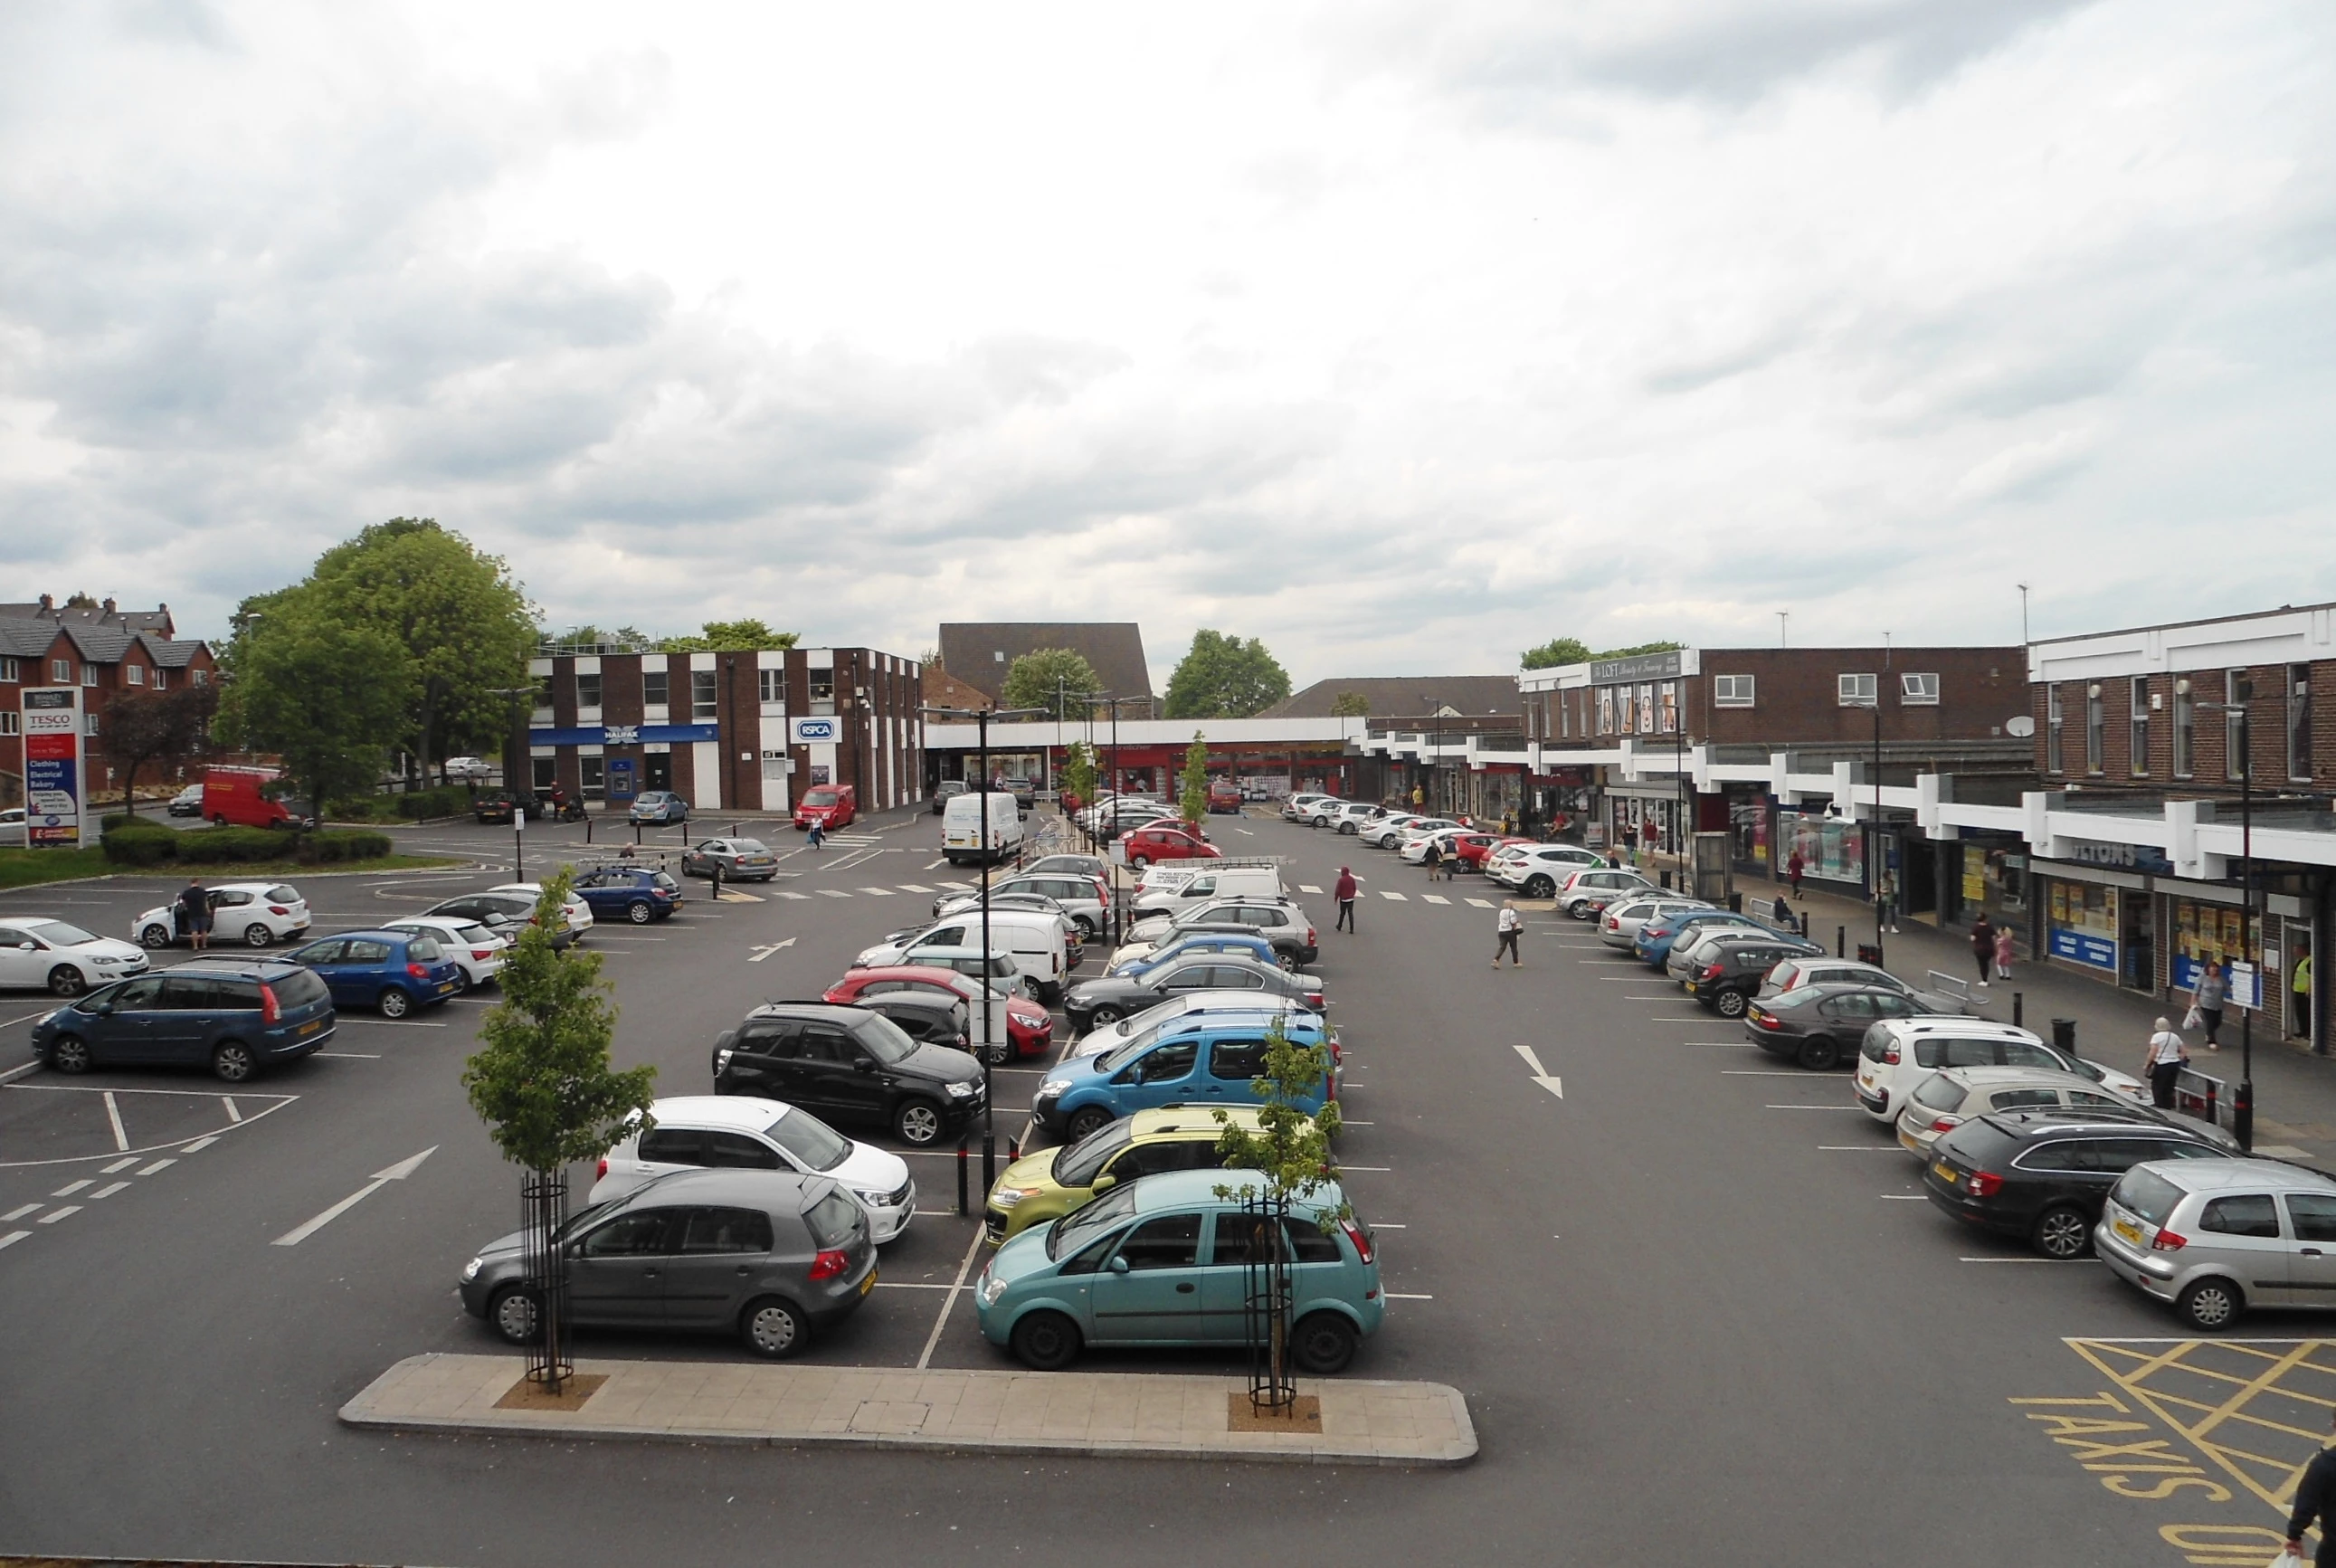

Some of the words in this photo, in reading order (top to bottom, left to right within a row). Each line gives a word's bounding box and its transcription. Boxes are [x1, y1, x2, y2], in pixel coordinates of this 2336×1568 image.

[1601, 663, 1619, 678] LOFT
[29, 715, 71, 725] TESCO
[802, 725, 831, 735] RSPCA
[30, 760, 61, 769] Clothing
[30, 770, 62, 778] Electrical
[30, 780, 55, 789] Bakery
[2007, 1391, 2233, 1503] TAXIS
